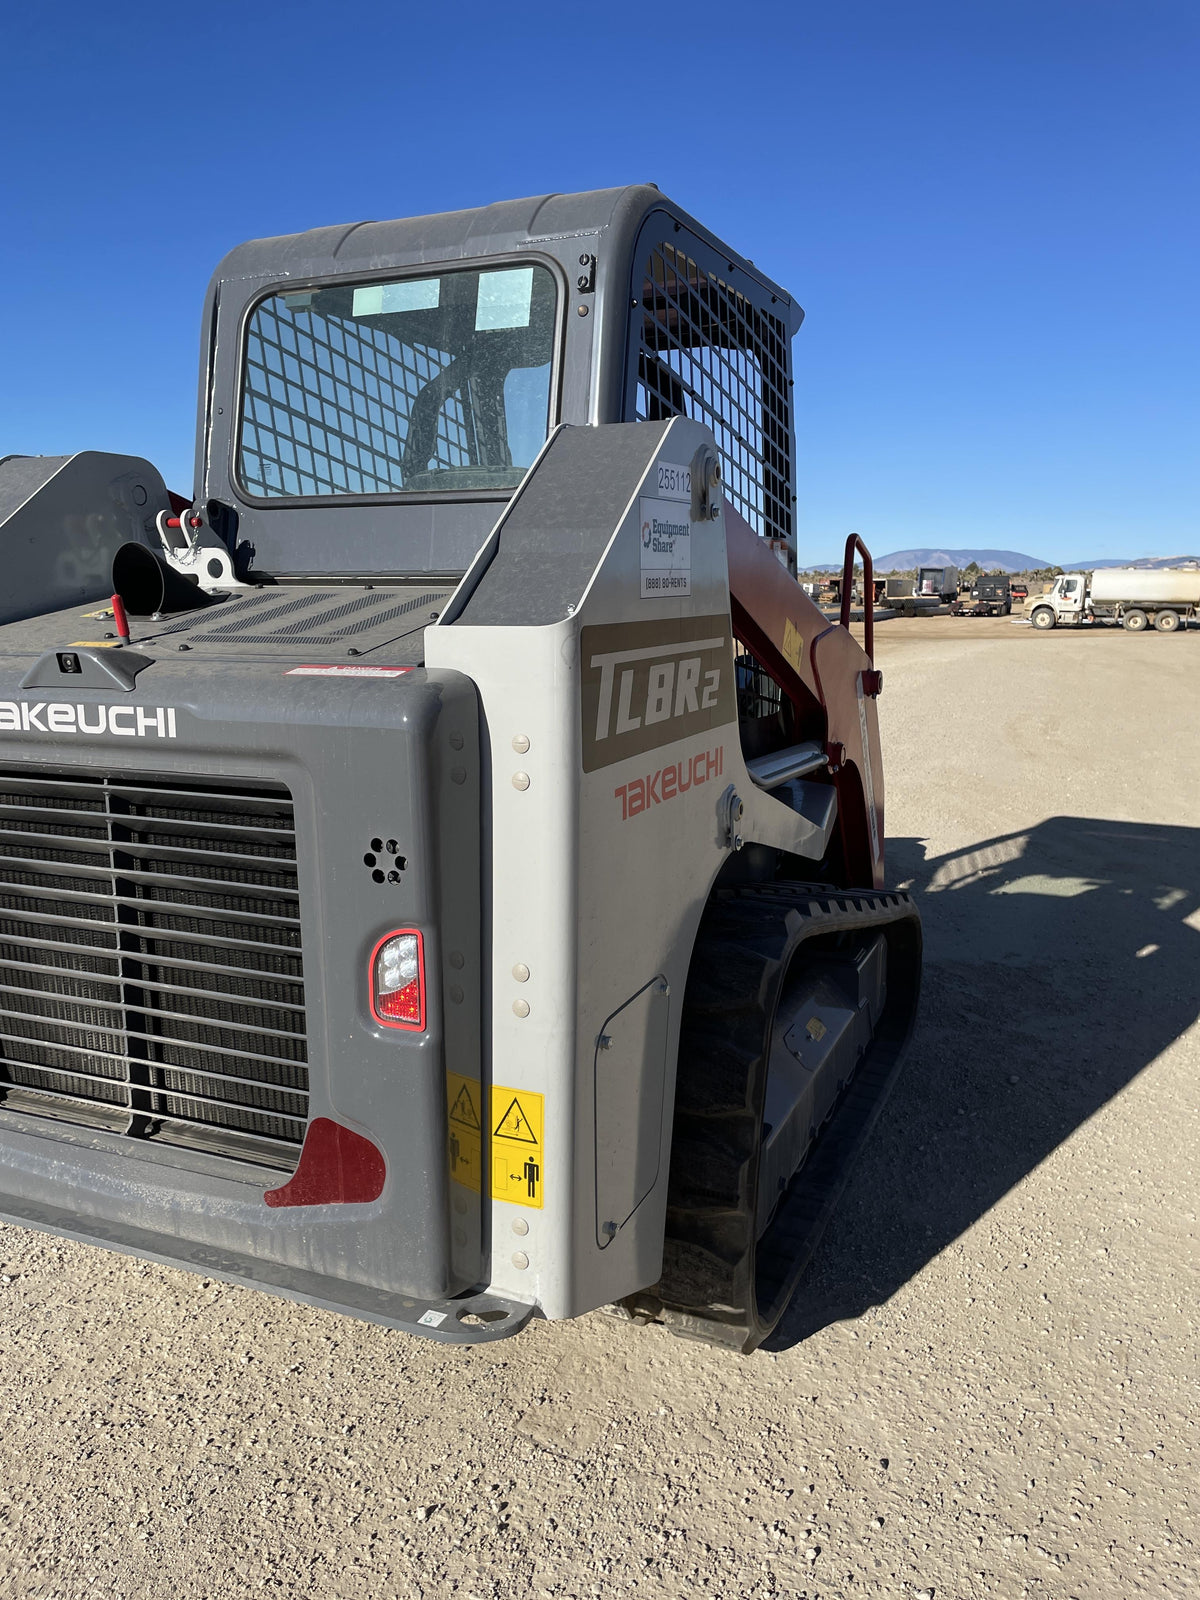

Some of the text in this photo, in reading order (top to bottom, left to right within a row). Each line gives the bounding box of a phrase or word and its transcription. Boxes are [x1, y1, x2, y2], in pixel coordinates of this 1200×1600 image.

[658, 467, 691, 493] 255112
[652, 518, 690, 539] Equipment
[645, 577, 661, 590] (888)
[590, 637, 725, 741] TL8R2
